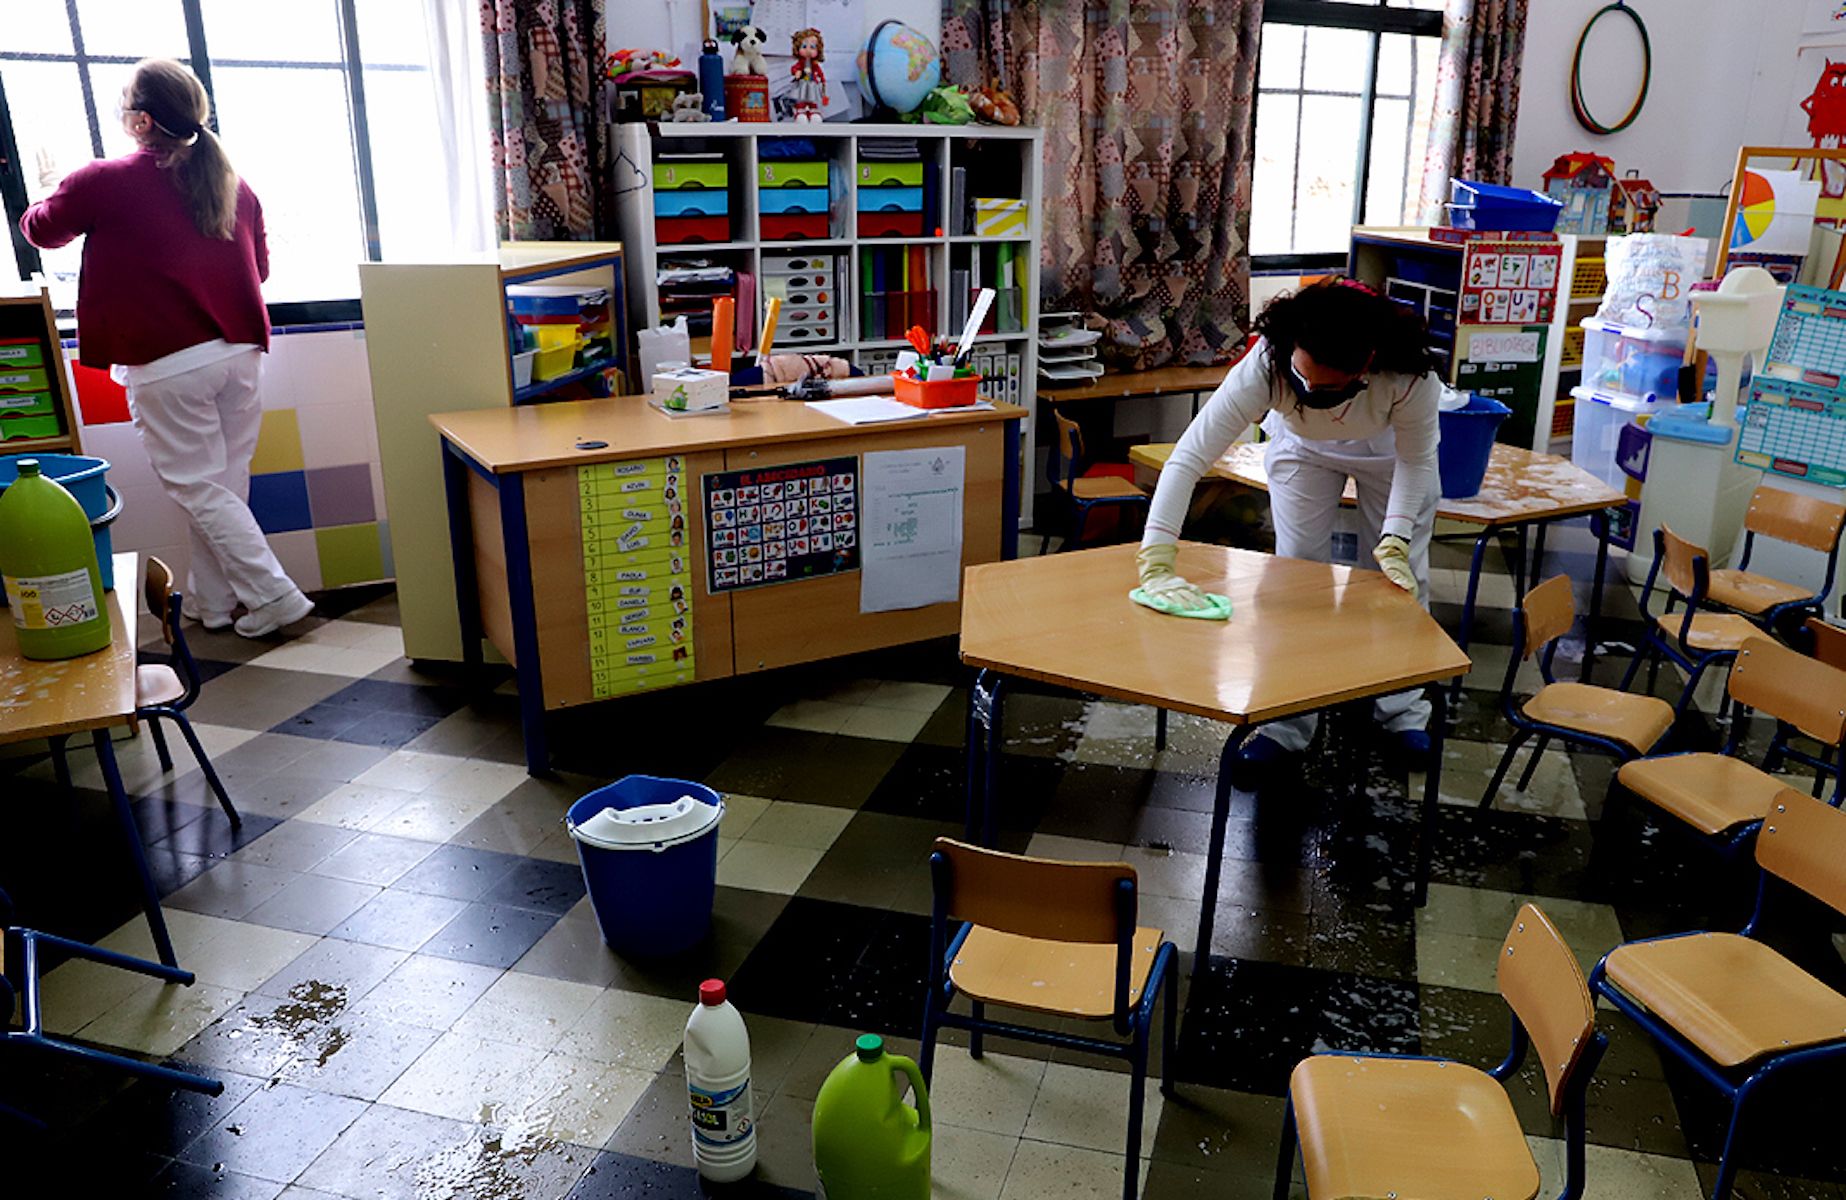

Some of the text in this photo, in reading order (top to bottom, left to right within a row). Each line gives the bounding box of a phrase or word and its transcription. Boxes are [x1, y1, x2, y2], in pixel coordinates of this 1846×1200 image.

[764, 166, 775, 181] 2
[862, 166, 871, 179] 3
[1472, 256, 1483, 271] A
[1502, 257, 1510, 271] E
[1531, 258, 1536, 271] I
[1659, 270, 1681, 301] B
[1483, 292, 1495, 306] O
[1513, 292, 1524, 306] U
[1636, 293, 1655, 329] S
[1471, 336, 1536, 357] BIBLIOTECA
[740, 474, 752, 486] EL
[620, 572, 643, 580] PAOLA
[621, 625, 646, 633] BLANCA
